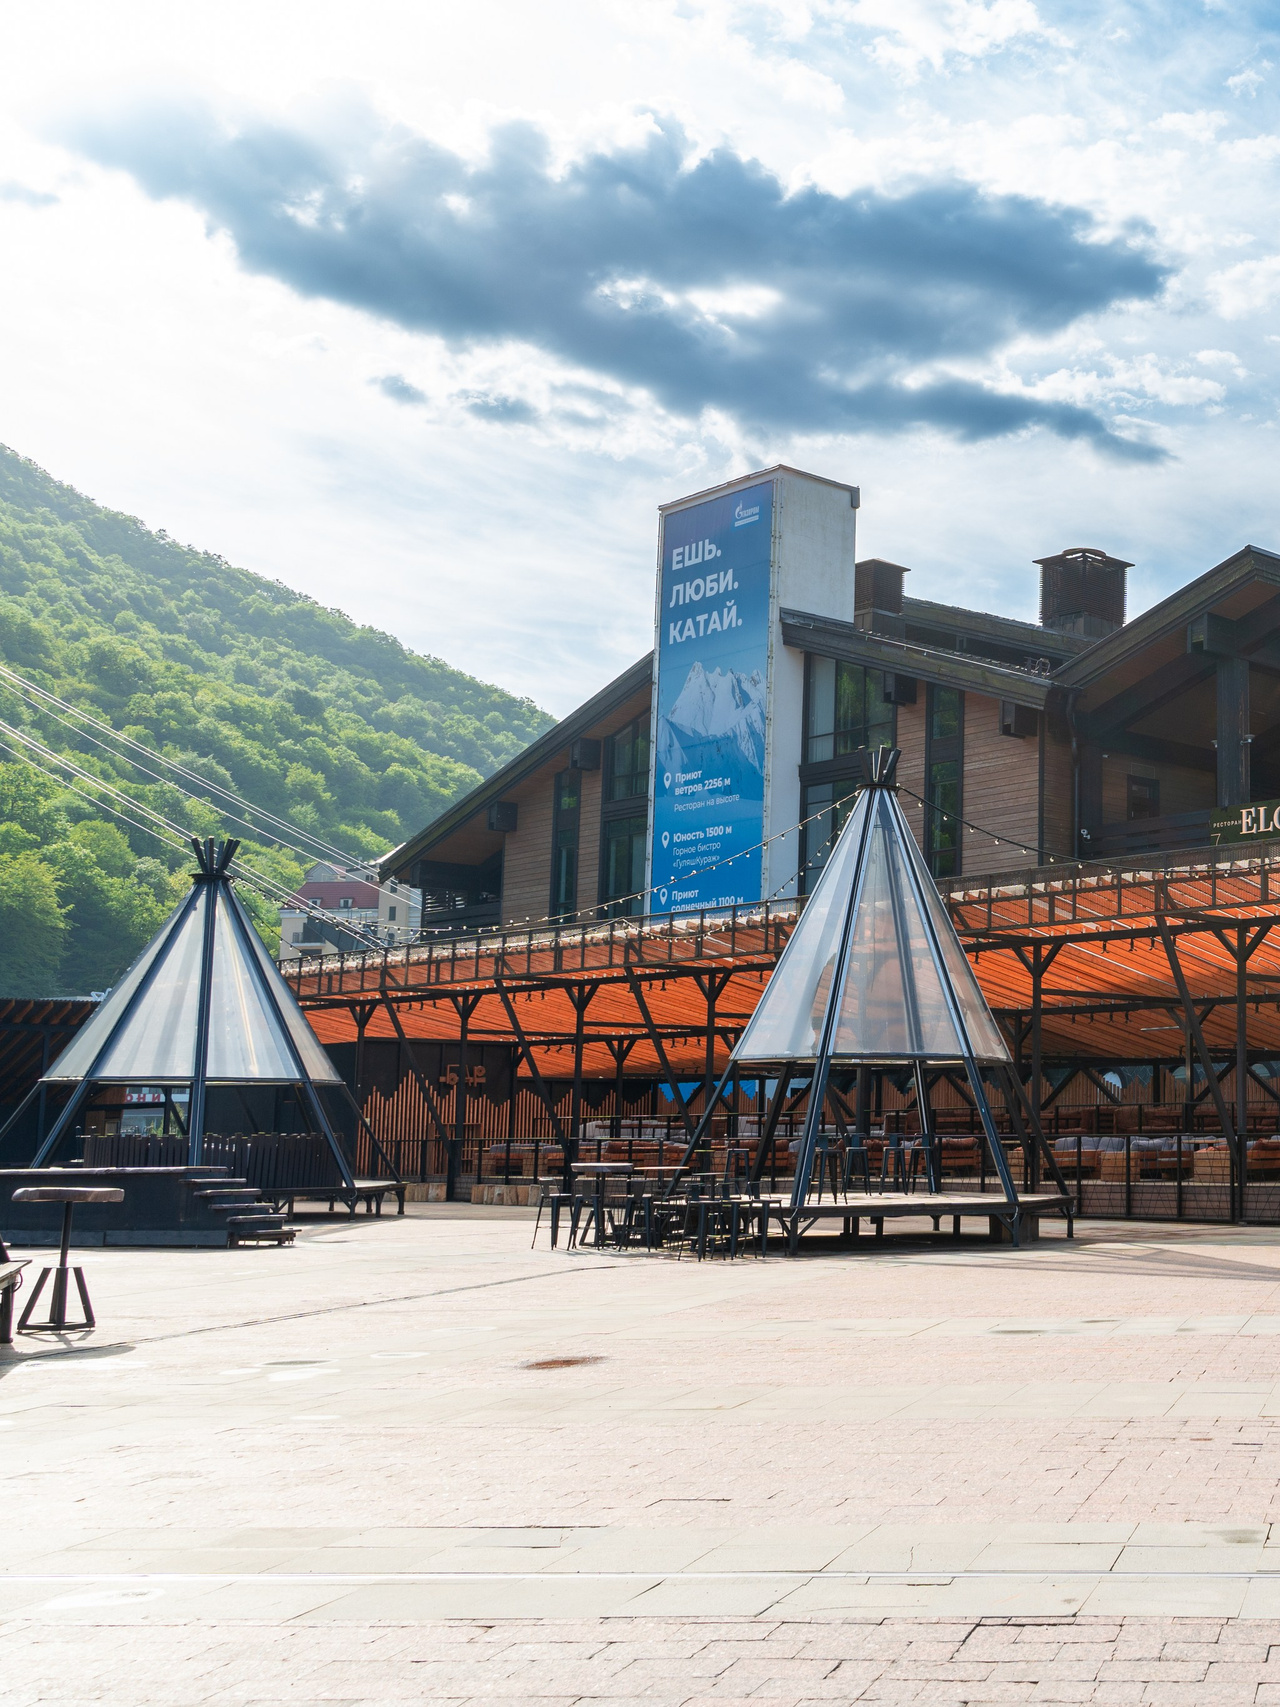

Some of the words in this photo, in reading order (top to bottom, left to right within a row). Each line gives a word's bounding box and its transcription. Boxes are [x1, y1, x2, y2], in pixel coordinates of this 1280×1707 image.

[672, 539, 722, 571] ЕШЬ.
[669, 568, 739, 608] ЛЮБИ.
[669, 600, 743, 645] КАТАЙ.
[675, 770, 703, 784] Приют
[674, 783, 703, 796] ветров
[704, 777, 723, 790] 2256
[674, 801, 705, 812] Ресторан
[716, 794, 740, 804] высоте
[1213, 819, 1242, 828] РЕСТОРАН
[673, 831, 705, 843] Юность
[706, 825, 724, 837] 1500
[673, 847, 696, 856] Горное
[697, 842, 721, 852] бистро
[671, 889, 699, 901] Приют
[671, 897, 717, 912] солнечный
[718, 896, 735, 907] 1100
